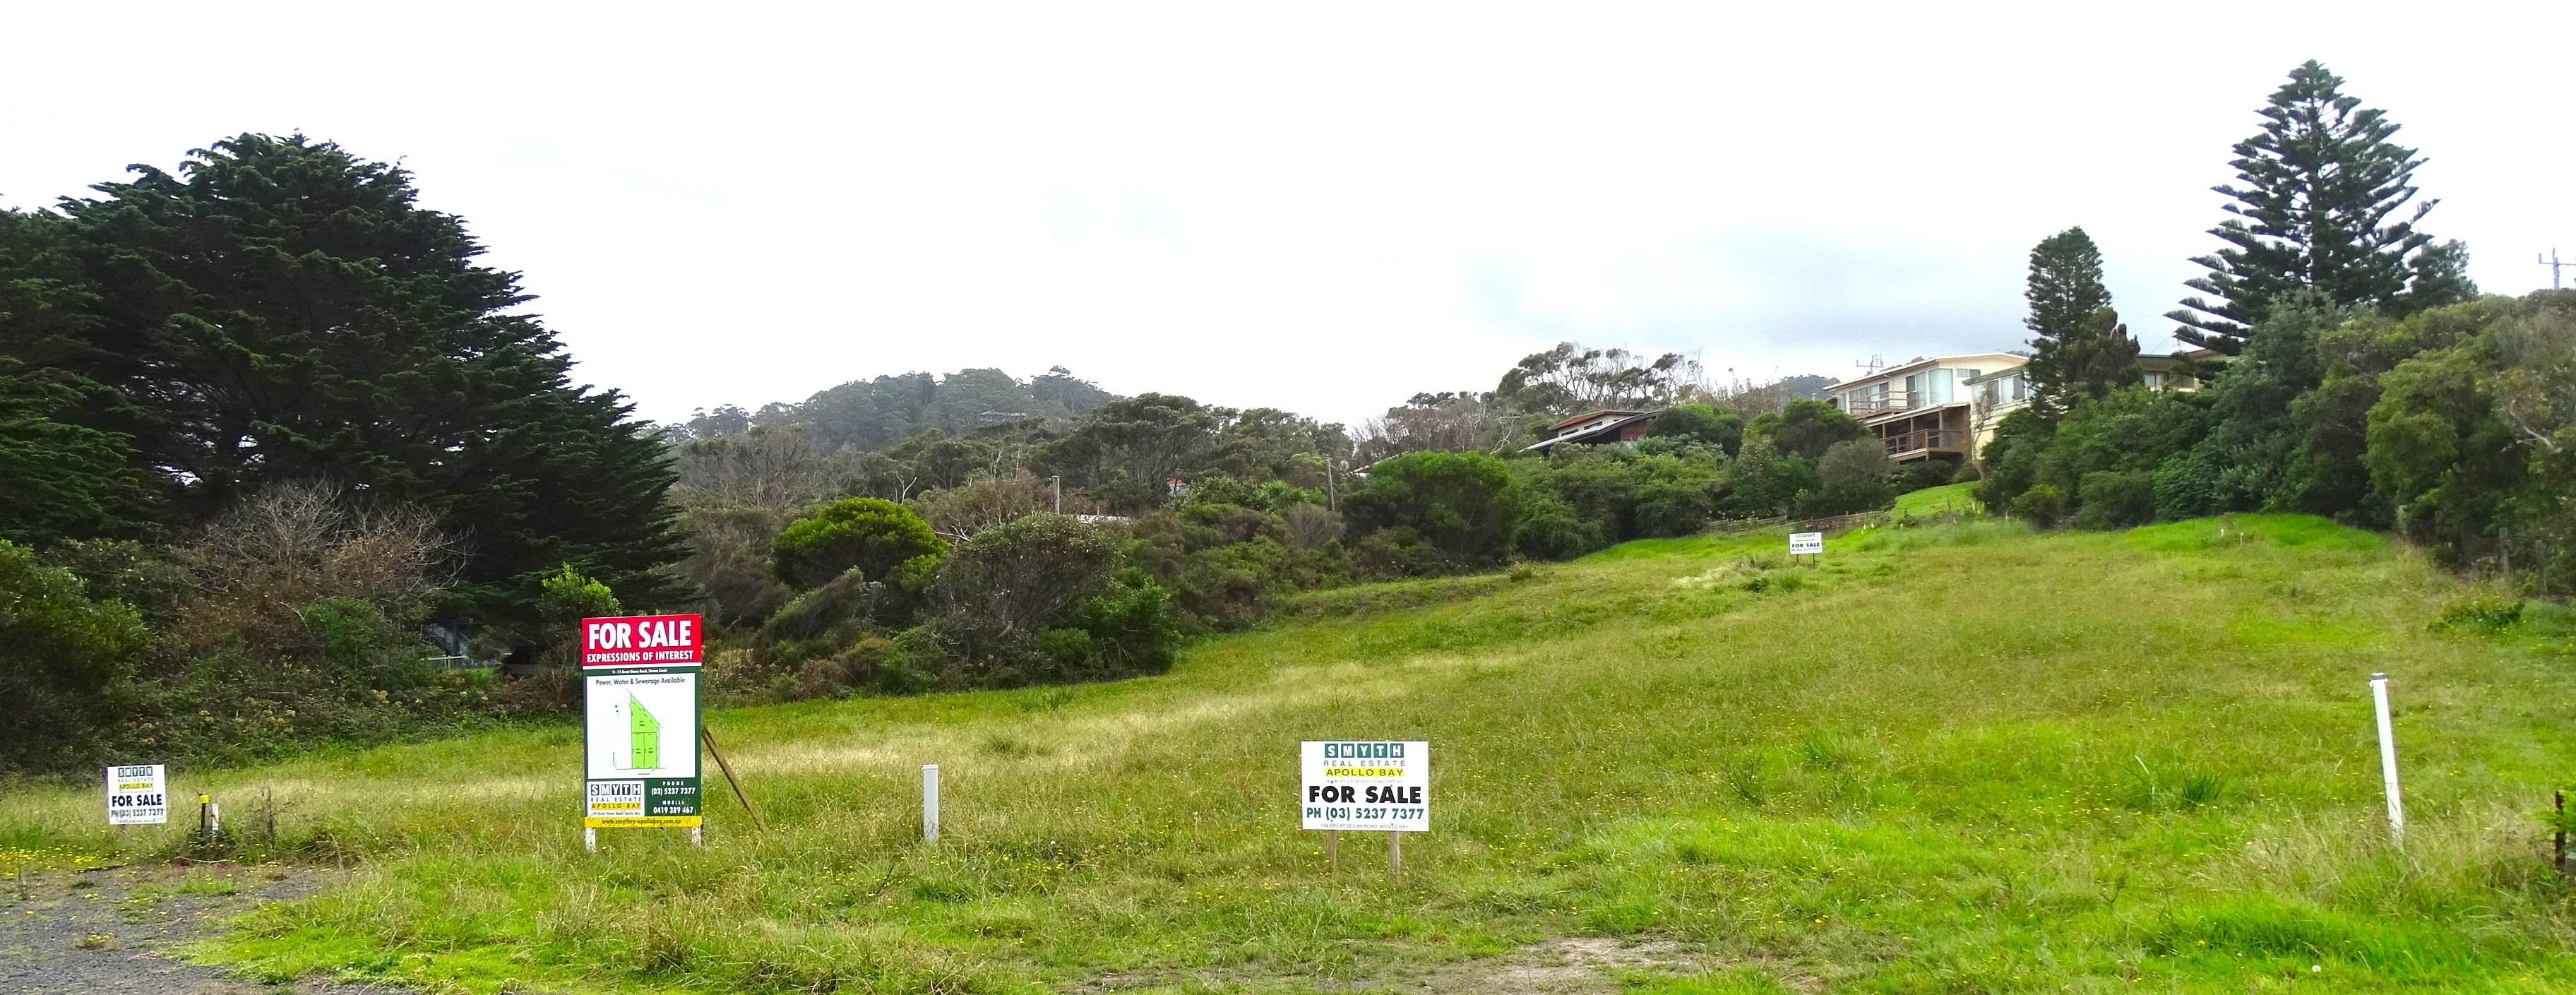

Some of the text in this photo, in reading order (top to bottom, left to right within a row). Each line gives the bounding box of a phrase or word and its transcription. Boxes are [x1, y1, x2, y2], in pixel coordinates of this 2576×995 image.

[589, 620, 691, 649] FOR SALE
[587, 650, 693, 662] EXPRESSIONS OF INTEREST
[1325, 744, 1404, 758] SMYTH
[591, 784, 641, 795] SMYTH
[651, 787, 663, 796] (03)
[1309, 785, 1421, 804] FOR SALE
[112, 794, 162, 806] FOR SALE
[1307, 807, 1424, 821] PH (03) 5237 7377
